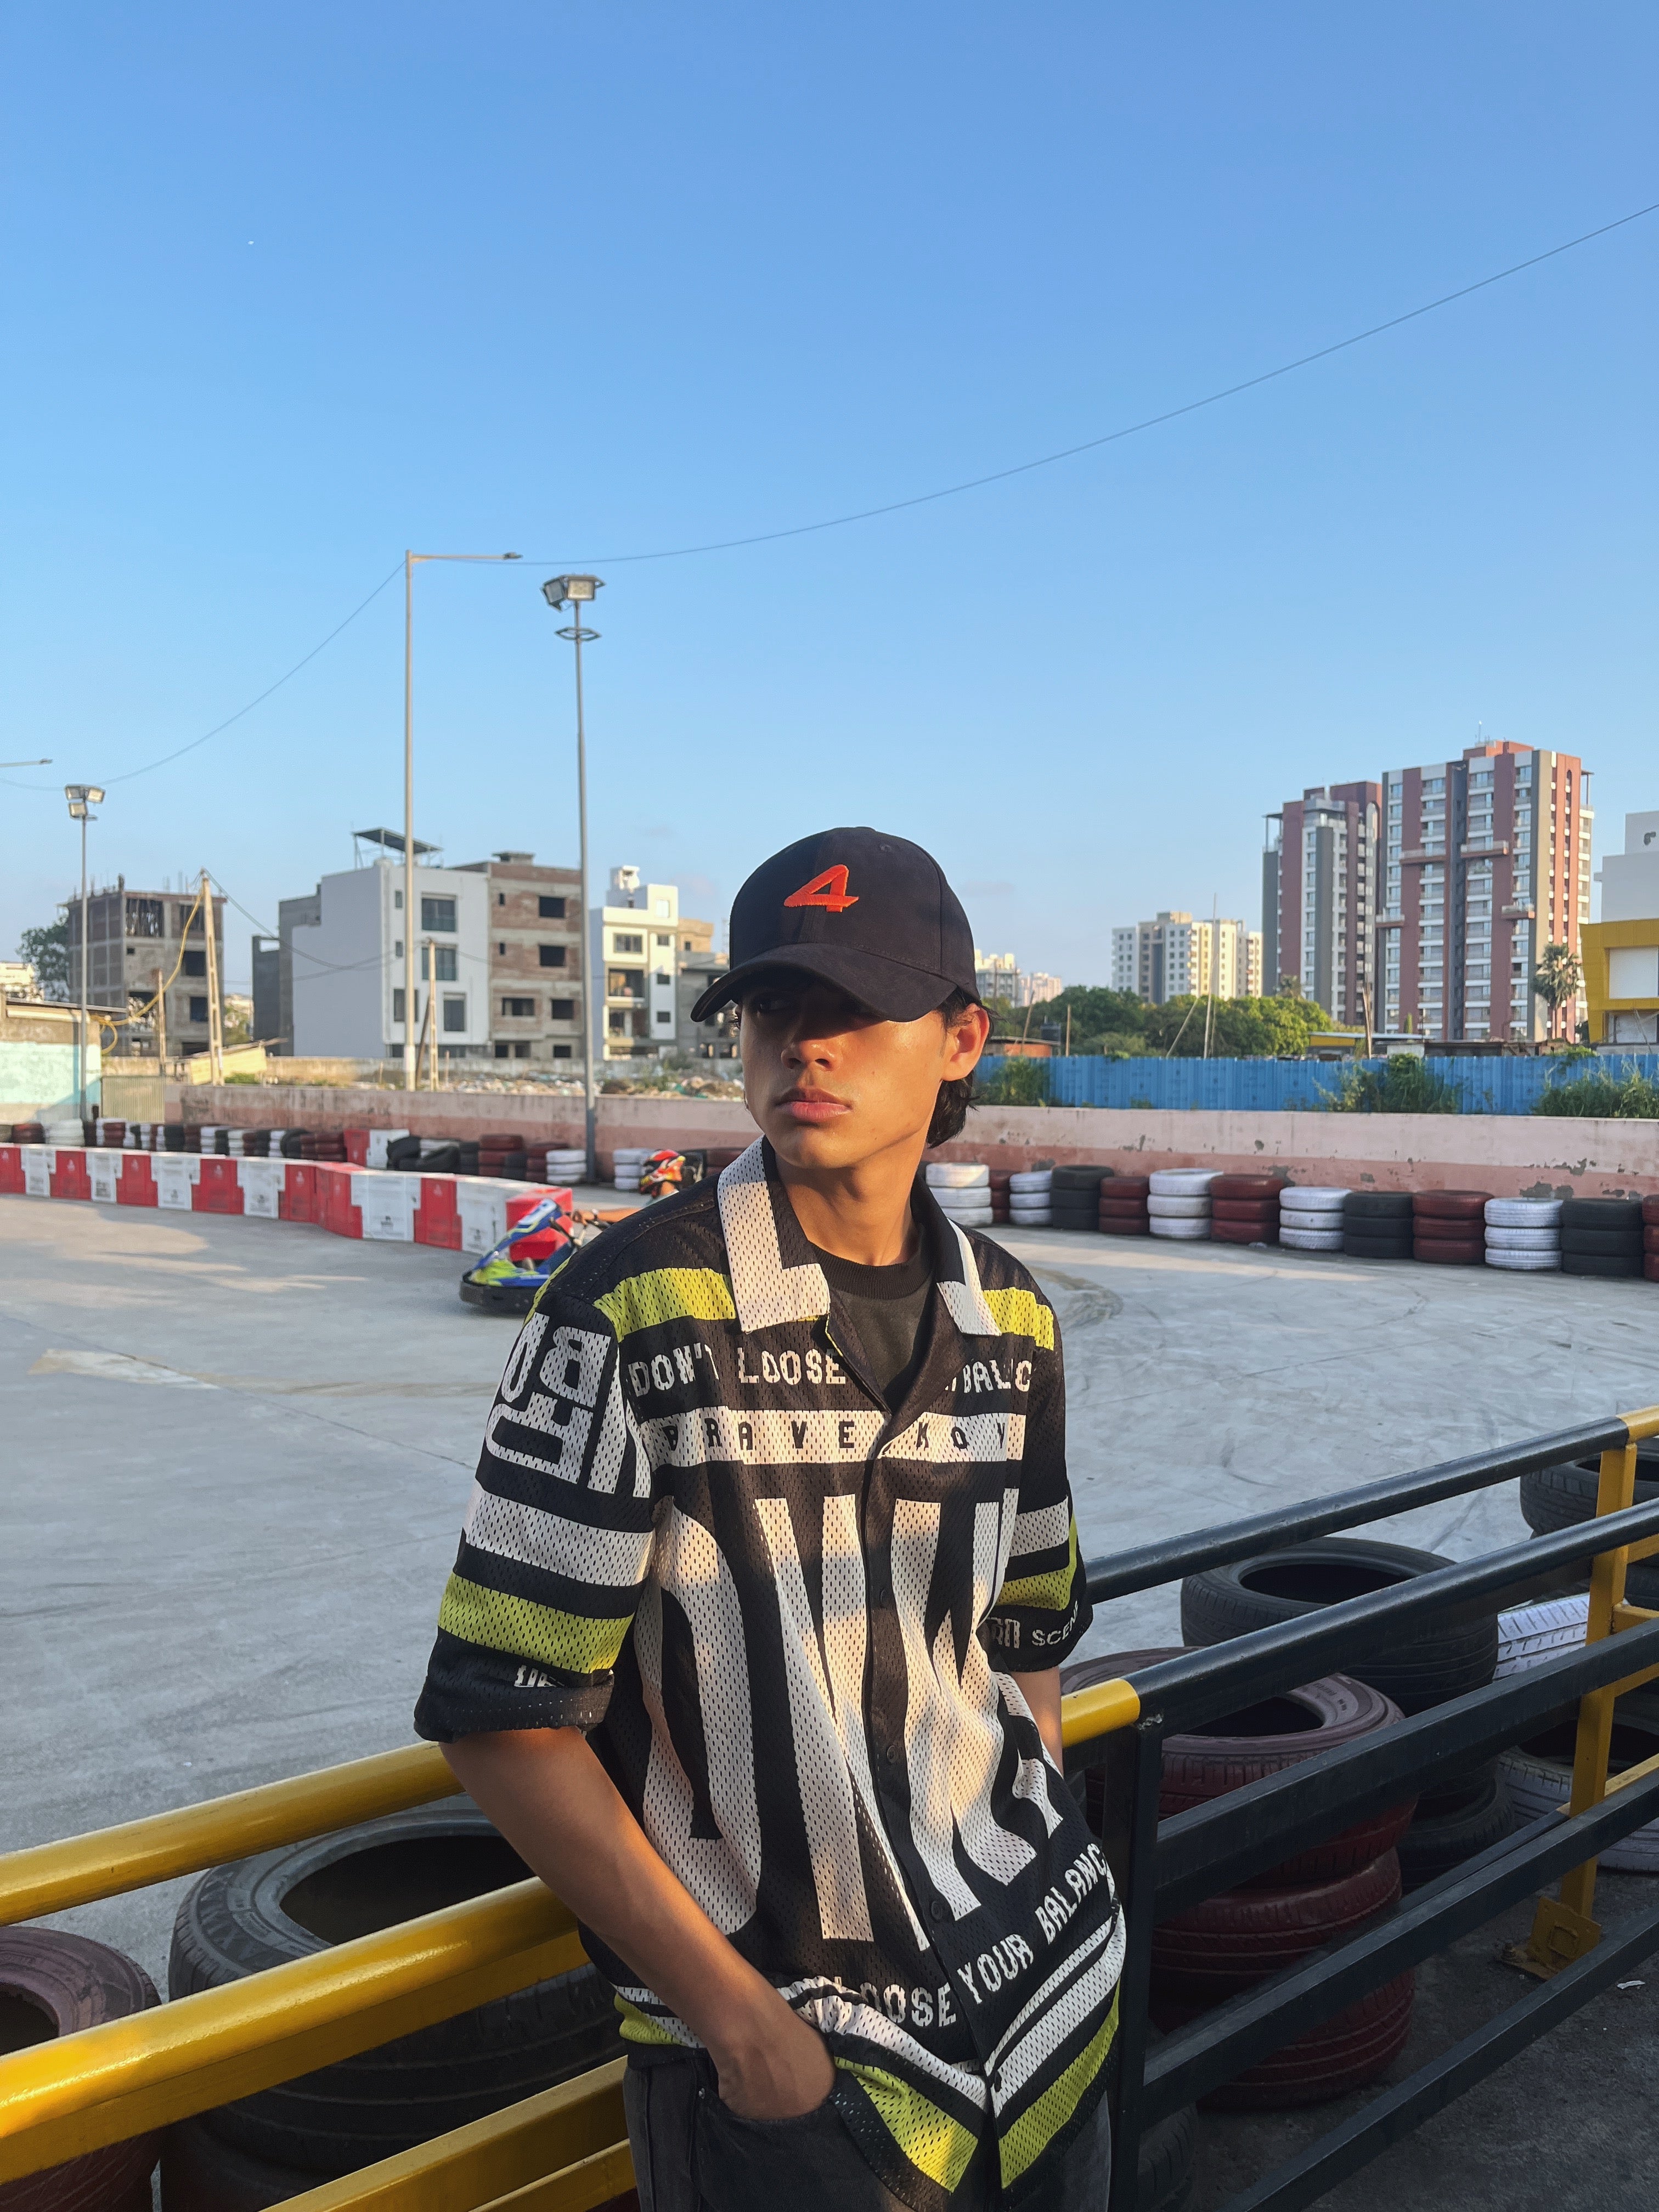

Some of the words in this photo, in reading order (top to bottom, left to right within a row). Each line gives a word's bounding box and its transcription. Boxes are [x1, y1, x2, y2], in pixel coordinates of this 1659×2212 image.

[783, 864, 859, 912] 4
[737, 1347, 846, 1385] LOOSE
[834, 1976, 956, 2028] OOSE
[957, 1934, 1034, 2005] YOUR
